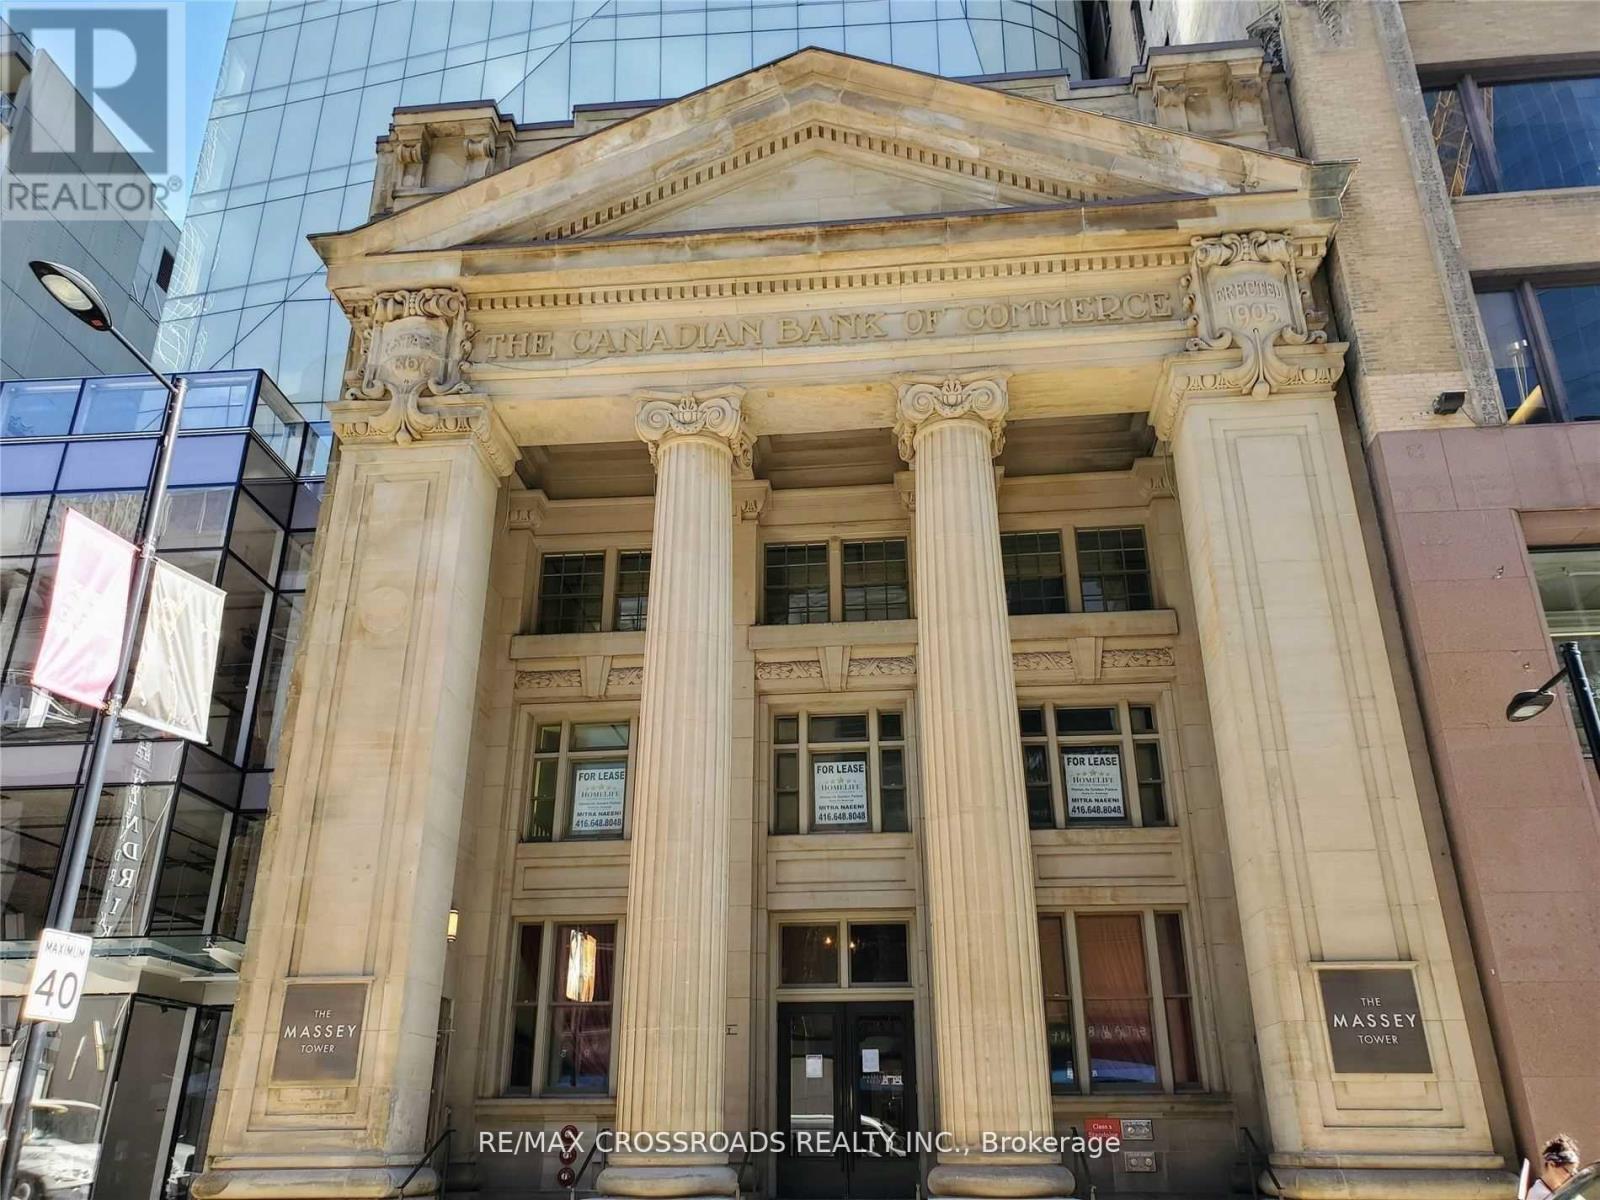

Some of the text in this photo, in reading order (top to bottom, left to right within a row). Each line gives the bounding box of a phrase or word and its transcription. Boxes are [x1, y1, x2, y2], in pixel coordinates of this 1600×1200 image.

[1227, 302, 1281, 327] 1905
[485, 292, 1174, 358] THE CANADIAN BANK OF COMMERCE
[1066, 757, 1117, 766] FOR LEASE
[816, 764, 864, 775] FOR LEASE
[578, 771, 625, 781] FOR LEASE
[45, 941, 87, 959] MAXIMUM
[34, 969, 79, 1009] 40
[1360, 997, 1382, 1007] THE
[313, 1009, 332, 1018] THE
[1333, 1013, 1416, 1028] MASSEY
[283, 1024, 357, 1039] MASSEY
[1358, 1034, 1399, 1045] TOWER
[300, 1044, 336, 1054] TOWER
